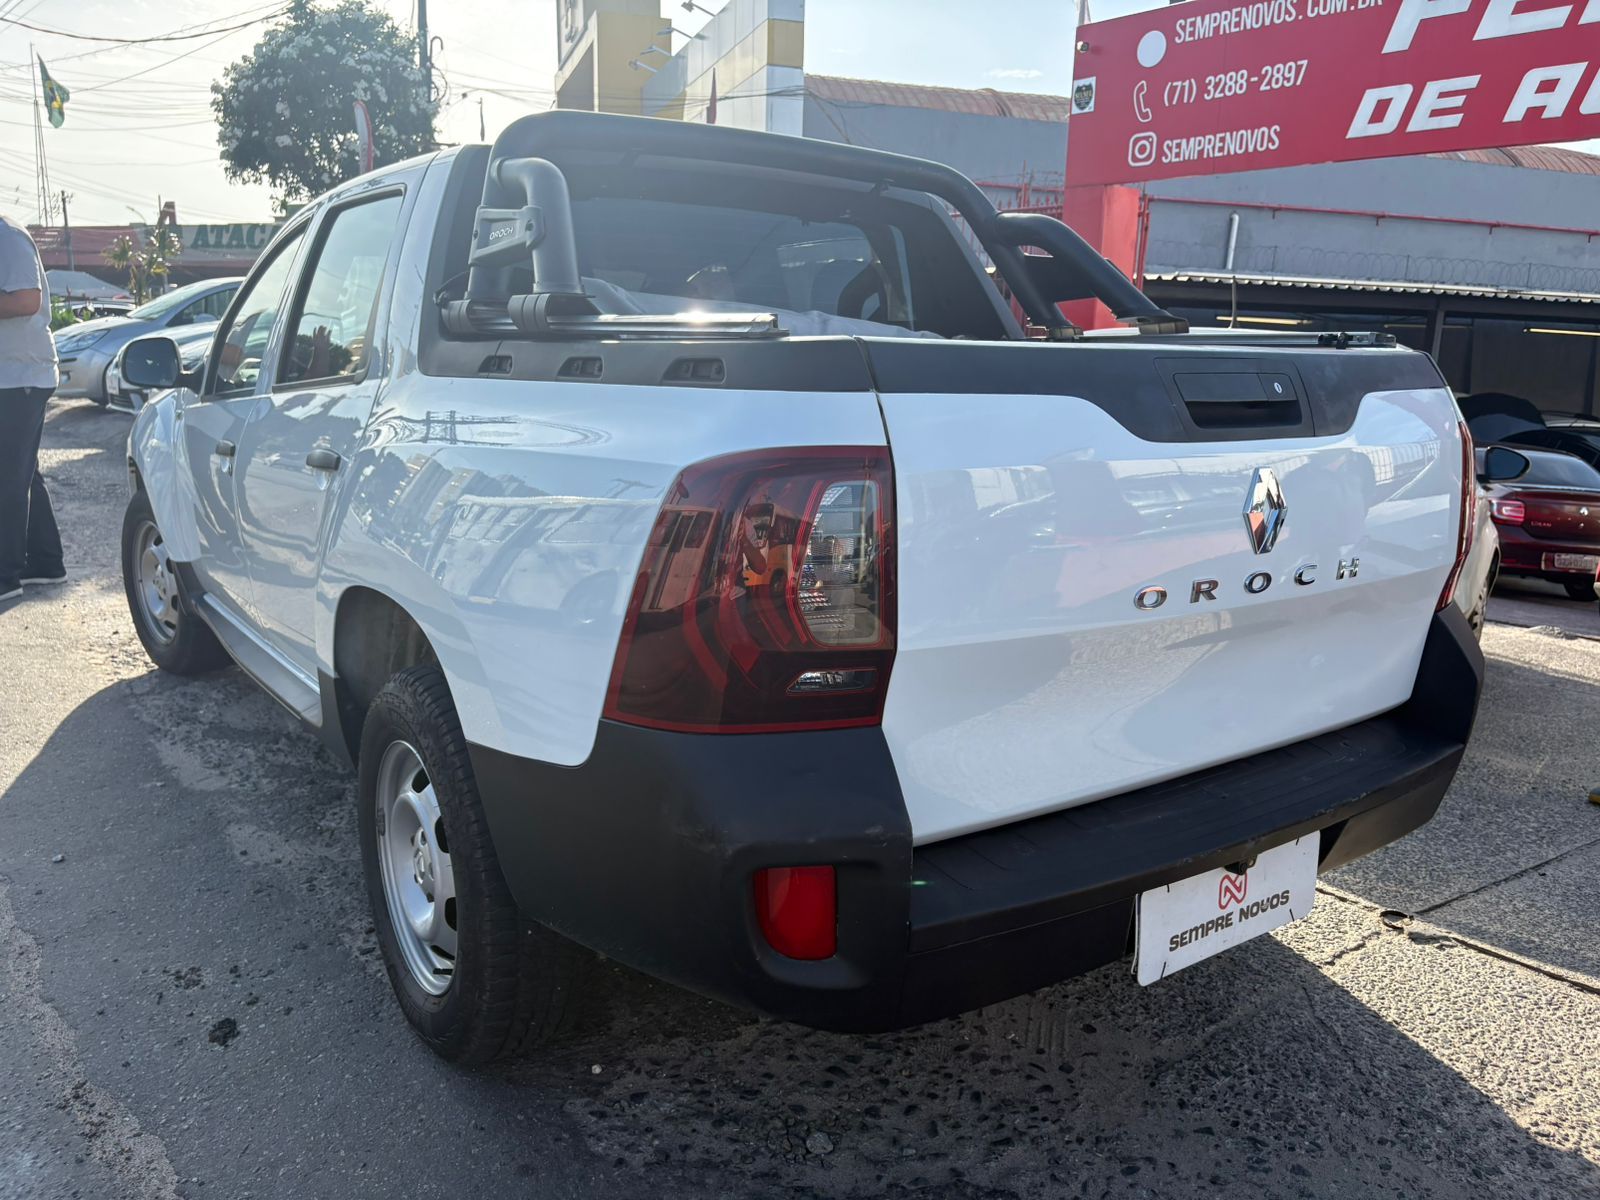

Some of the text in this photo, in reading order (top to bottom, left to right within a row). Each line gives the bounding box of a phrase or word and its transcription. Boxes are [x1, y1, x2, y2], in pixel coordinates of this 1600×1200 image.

[1164, 59, 1308, 107] (71) 3288-2897
[1345, 74, 1481, 139] DE
[1162, 125, 1280, 163] SEMPRENOVOS
[489, 227, 514, 240] OROCH
[1133, 557, 1360, 611] OROCH
[1169, 911, 1234, 952] SEMPRE
